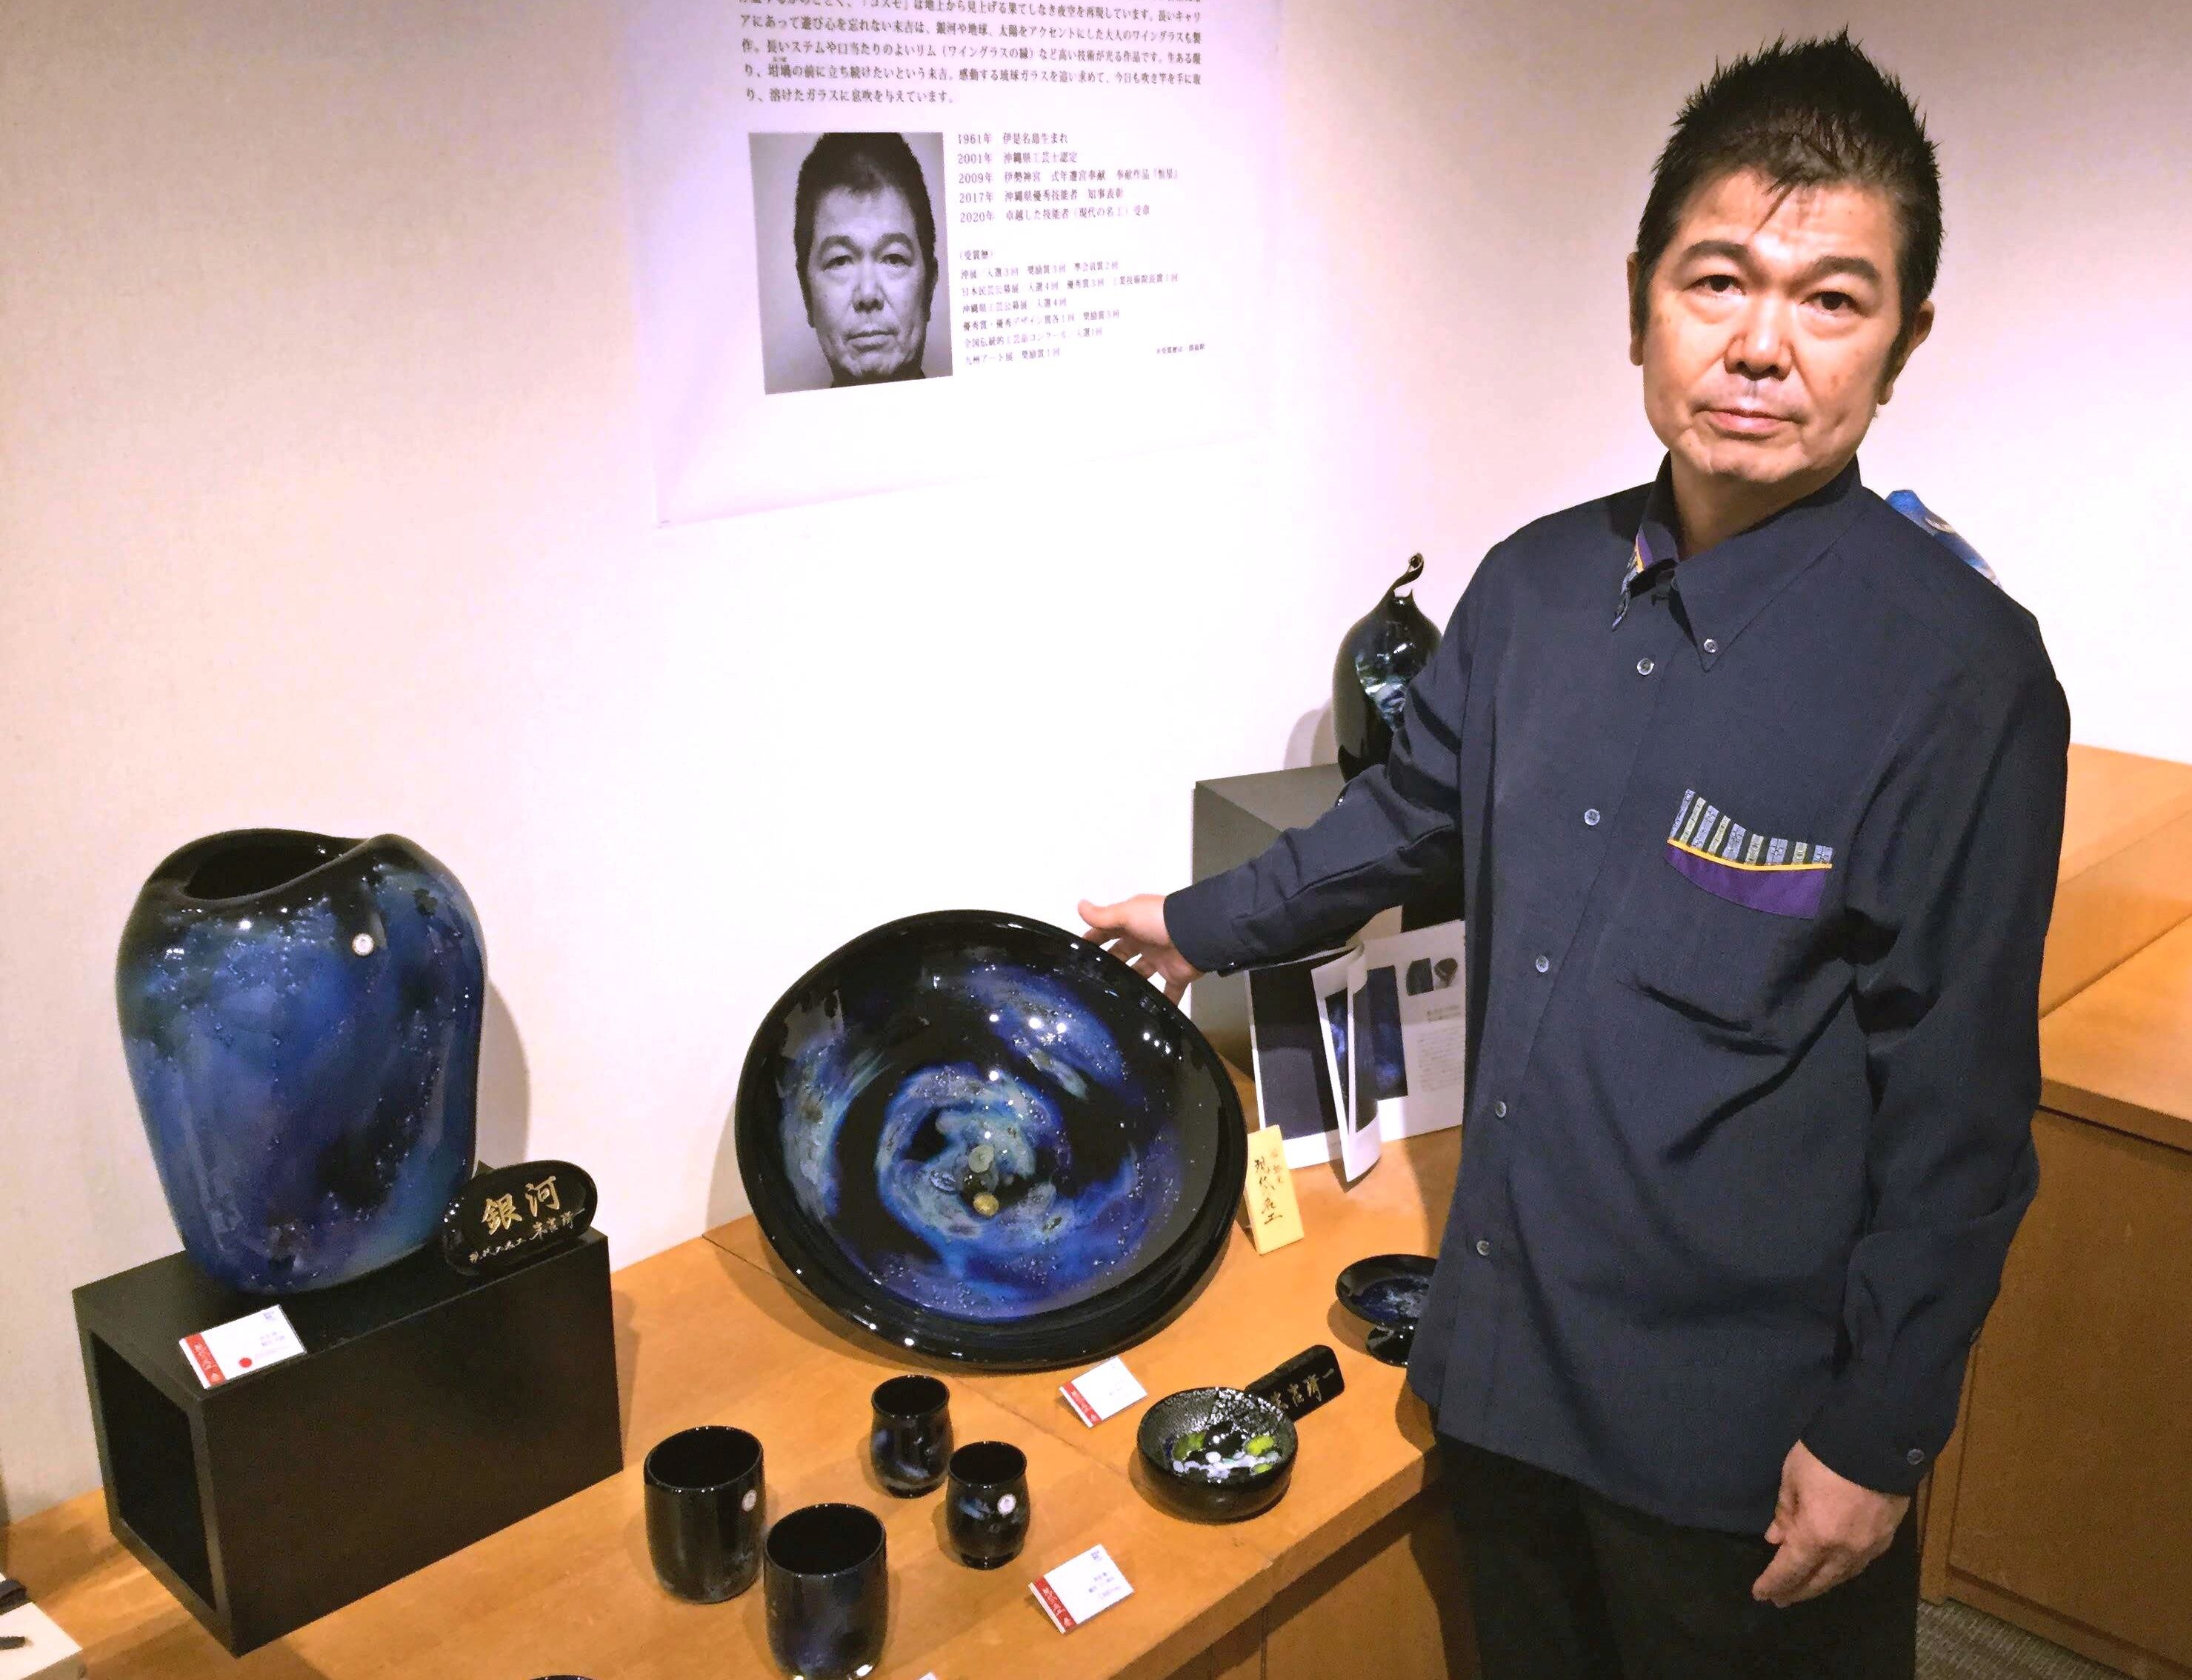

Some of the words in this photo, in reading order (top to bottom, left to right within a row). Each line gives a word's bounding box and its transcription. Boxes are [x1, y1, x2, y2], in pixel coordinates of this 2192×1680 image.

[958, 133, 992, 144] 1961年
[1003, 132, 1068, 144] 伊是名島生まれ
[957, 152, 992, 164] 2001年
[959, 171, 993, 184] 2009年
[1005, 171, 1041, 184] 伊勢神宮
[959, 190, 993, 204] 2017年
[1005, 188, 1078, 202] 沖縄県優秀技能者
[961, 210, 995, 222] 2020年
[481, 1175, 560, 1236] 銀河
